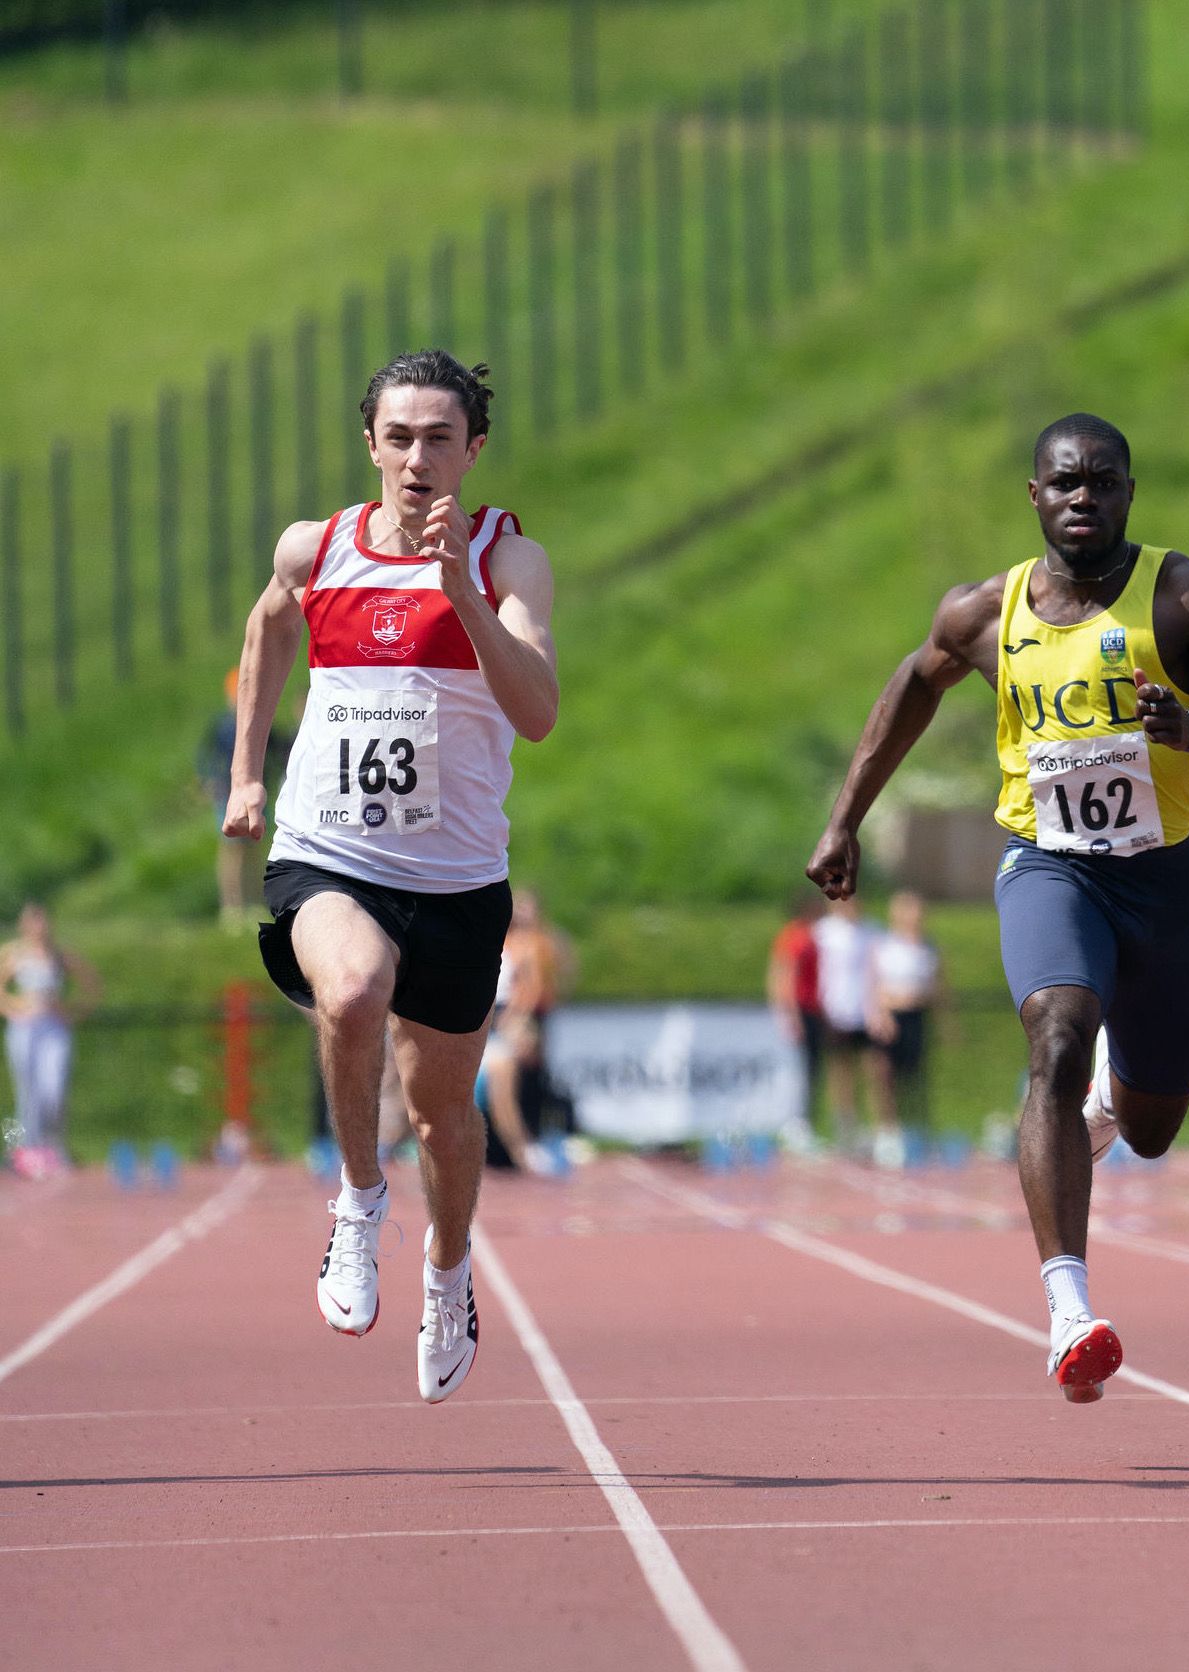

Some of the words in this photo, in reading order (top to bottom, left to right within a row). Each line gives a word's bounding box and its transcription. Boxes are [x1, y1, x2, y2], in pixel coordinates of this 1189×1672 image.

[1103, 638, 1123, 646] UCD
[350, 706, 428, 723] Tripadvisor
[1009, 677, 1137, 732] UCD
[339, 737, 418, 796] 163
[1058, 751, 1139, 771] Tripadvisor
[1054, 777, 1138, 834] 162
[319, 809, 350, 823] IMC
